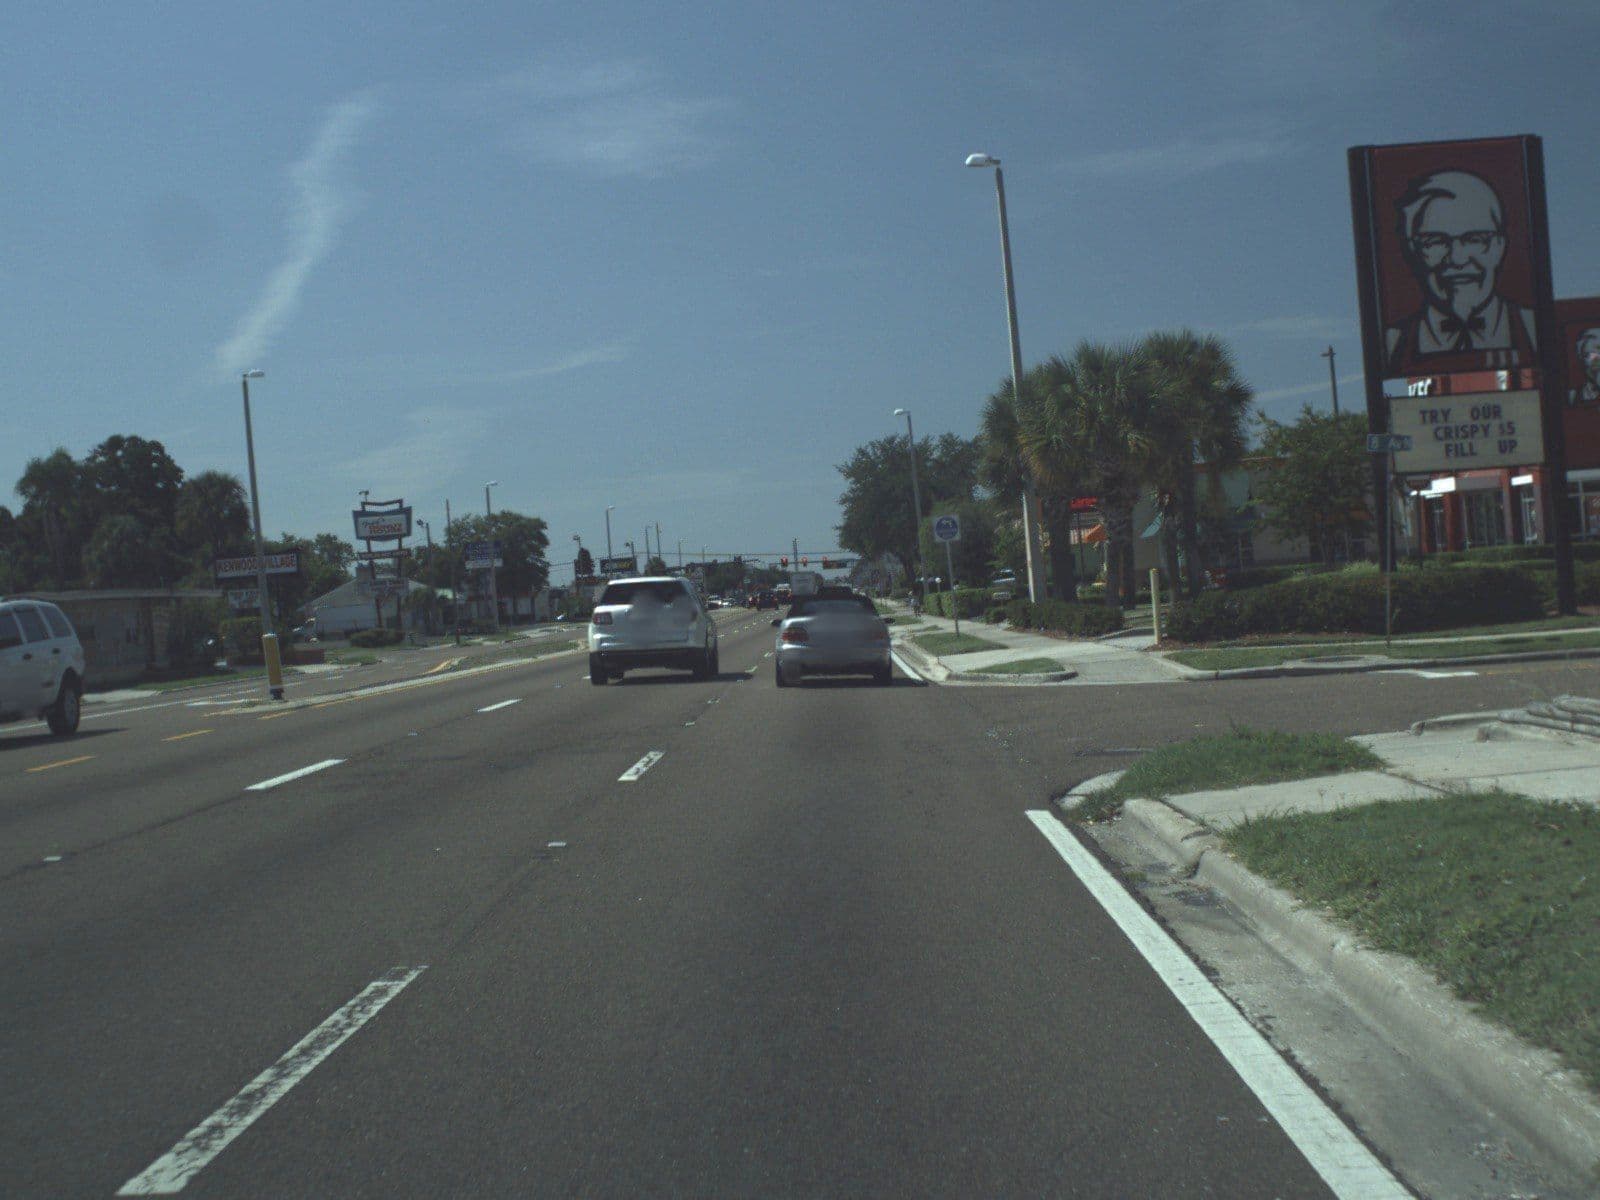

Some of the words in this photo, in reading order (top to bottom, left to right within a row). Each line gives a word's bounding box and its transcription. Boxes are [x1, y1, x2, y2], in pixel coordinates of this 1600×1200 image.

[1419, 408, 1451, 424] TRY
[1470, 403, 1502, 421] OUR
[1434, 422, 1490, 441] CRISPY
[1444, 442, 1477, 458] FILL
[1497, 439, 1518, 455] UP
